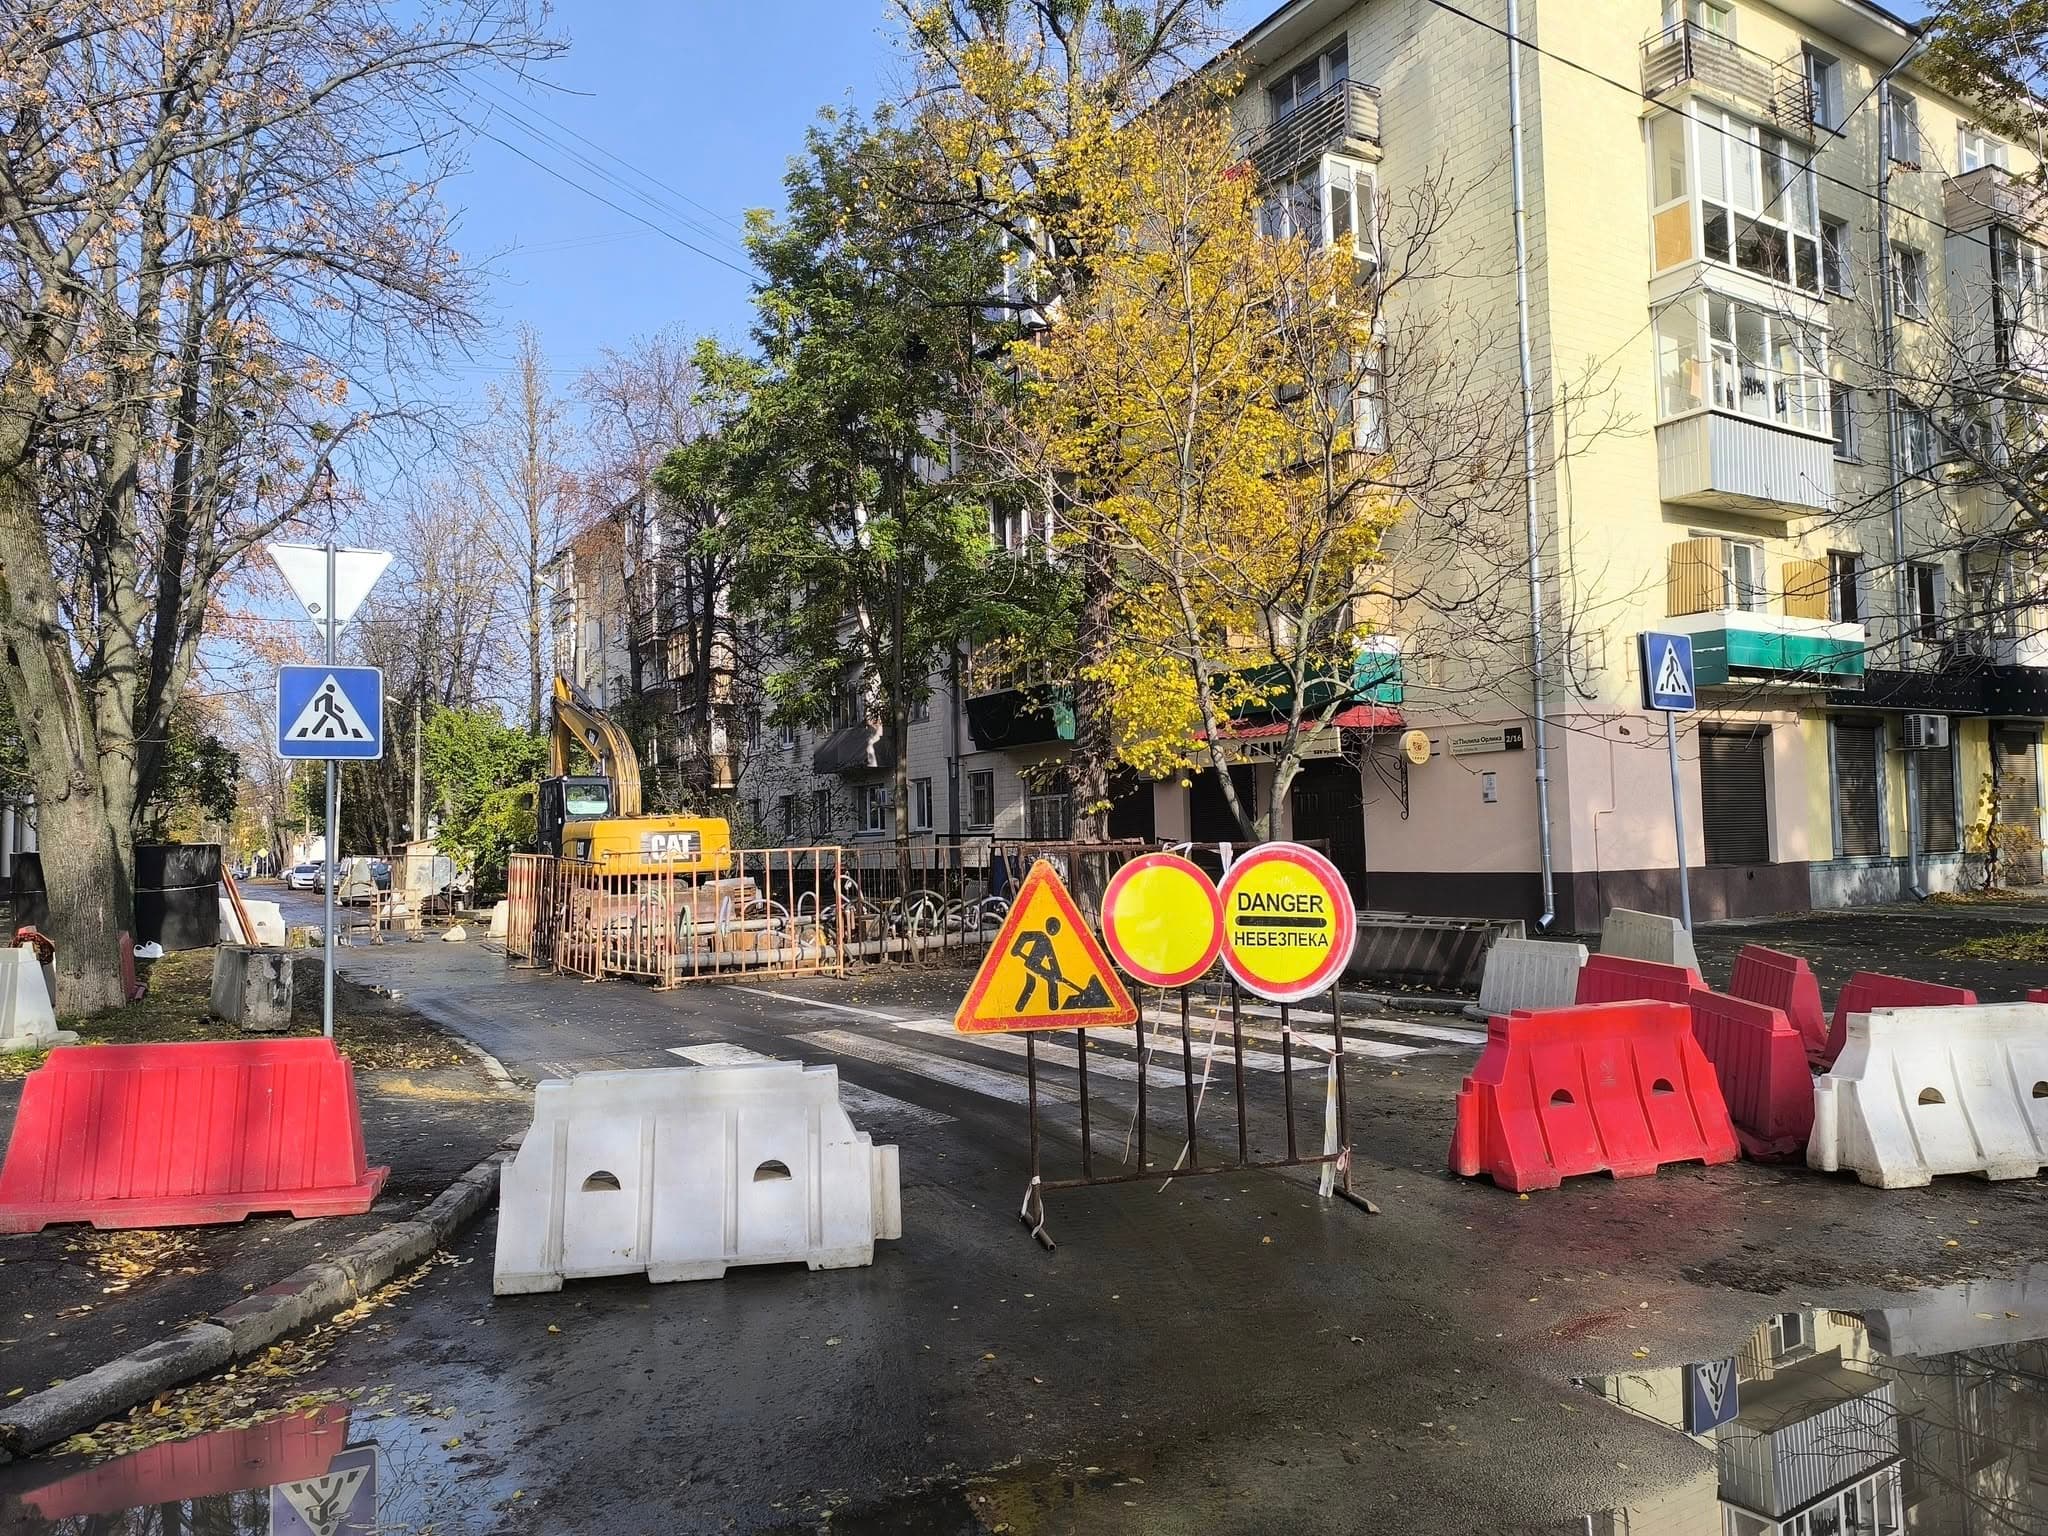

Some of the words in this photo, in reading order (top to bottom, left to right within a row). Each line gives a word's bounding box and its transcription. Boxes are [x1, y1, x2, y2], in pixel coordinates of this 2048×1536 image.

[1506, 734, 1522, 743] 2/16
[651, 834, 692, 860] CAT
[1238, 892, 1324, 913] DANGER
[1234, 931, 1329, 947] НЕБЕЗПЕКА
